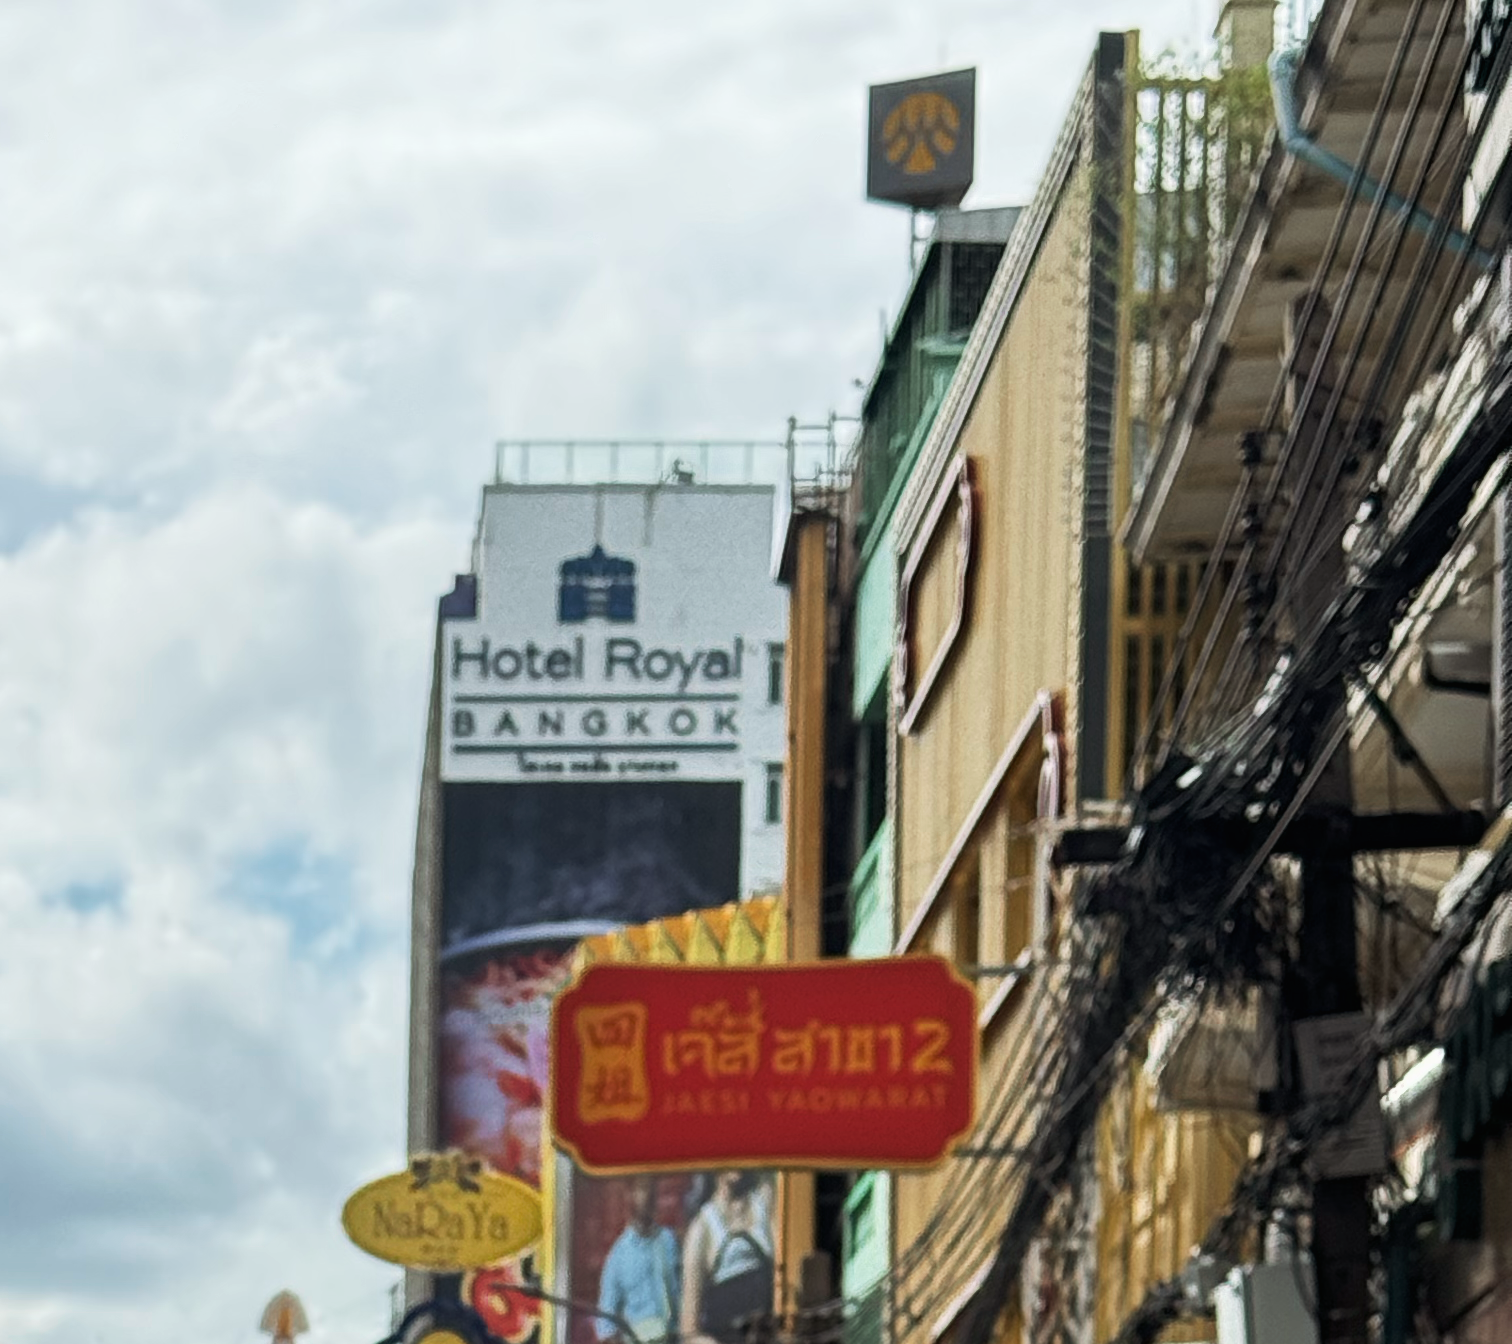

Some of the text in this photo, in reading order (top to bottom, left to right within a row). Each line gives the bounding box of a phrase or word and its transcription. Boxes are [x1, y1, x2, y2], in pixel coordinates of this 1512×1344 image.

[452, 634, 744, 694] Hotel Royal
[451, 707, 738, 738] BANGKOK
[767, 1083, 949, 1113] YAOWARAT
